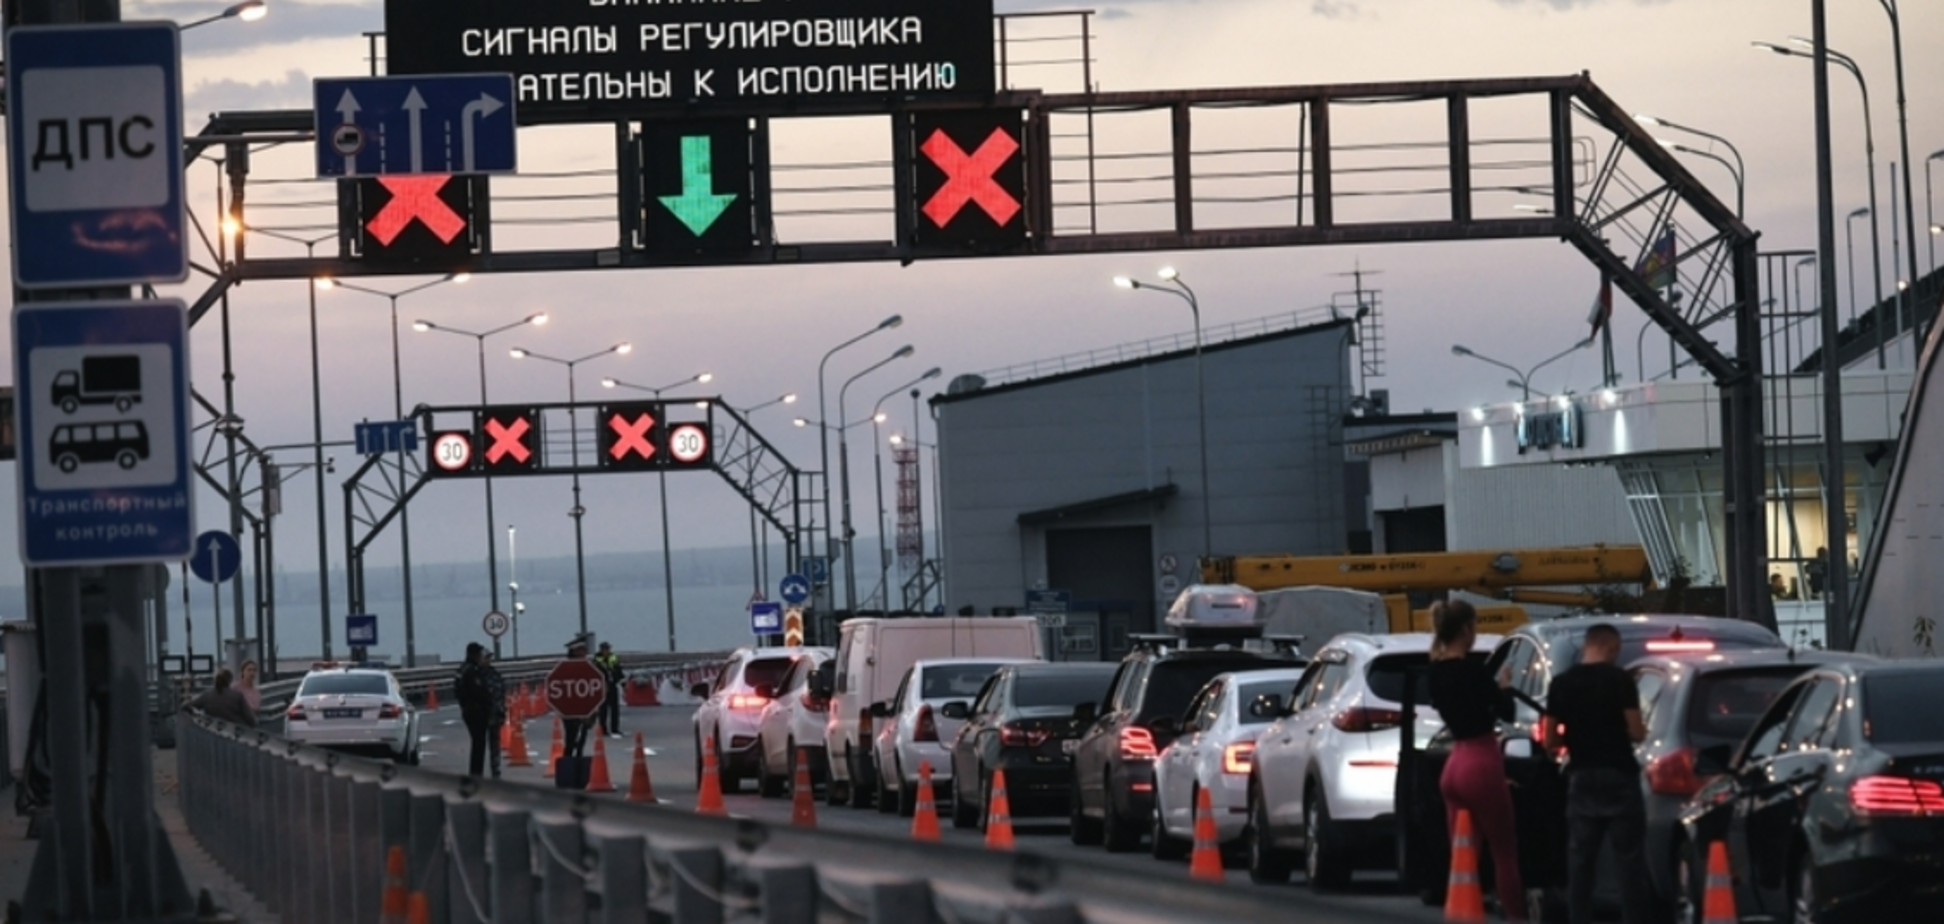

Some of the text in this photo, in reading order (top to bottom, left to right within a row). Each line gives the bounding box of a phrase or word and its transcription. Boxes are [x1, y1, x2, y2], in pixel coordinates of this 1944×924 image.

[462, 16, 922, 56] СИГНАЛЫ РЕГУЛИРОВЩИКА
[518, 62, 956, 101] АТЕЛЬНЫ К ИСПОЛНЕНИЮ
[32, 115, 155, 171] ДПС
[442, 442, 462, 461] 30
[678, 434, 699, 453] 30
[28, 492, 187, 518] Транспортный
[55, 523, 158, 542] контроль
[489, 617, 504, 630] 30
[550, 678, 601, 699] STOP
